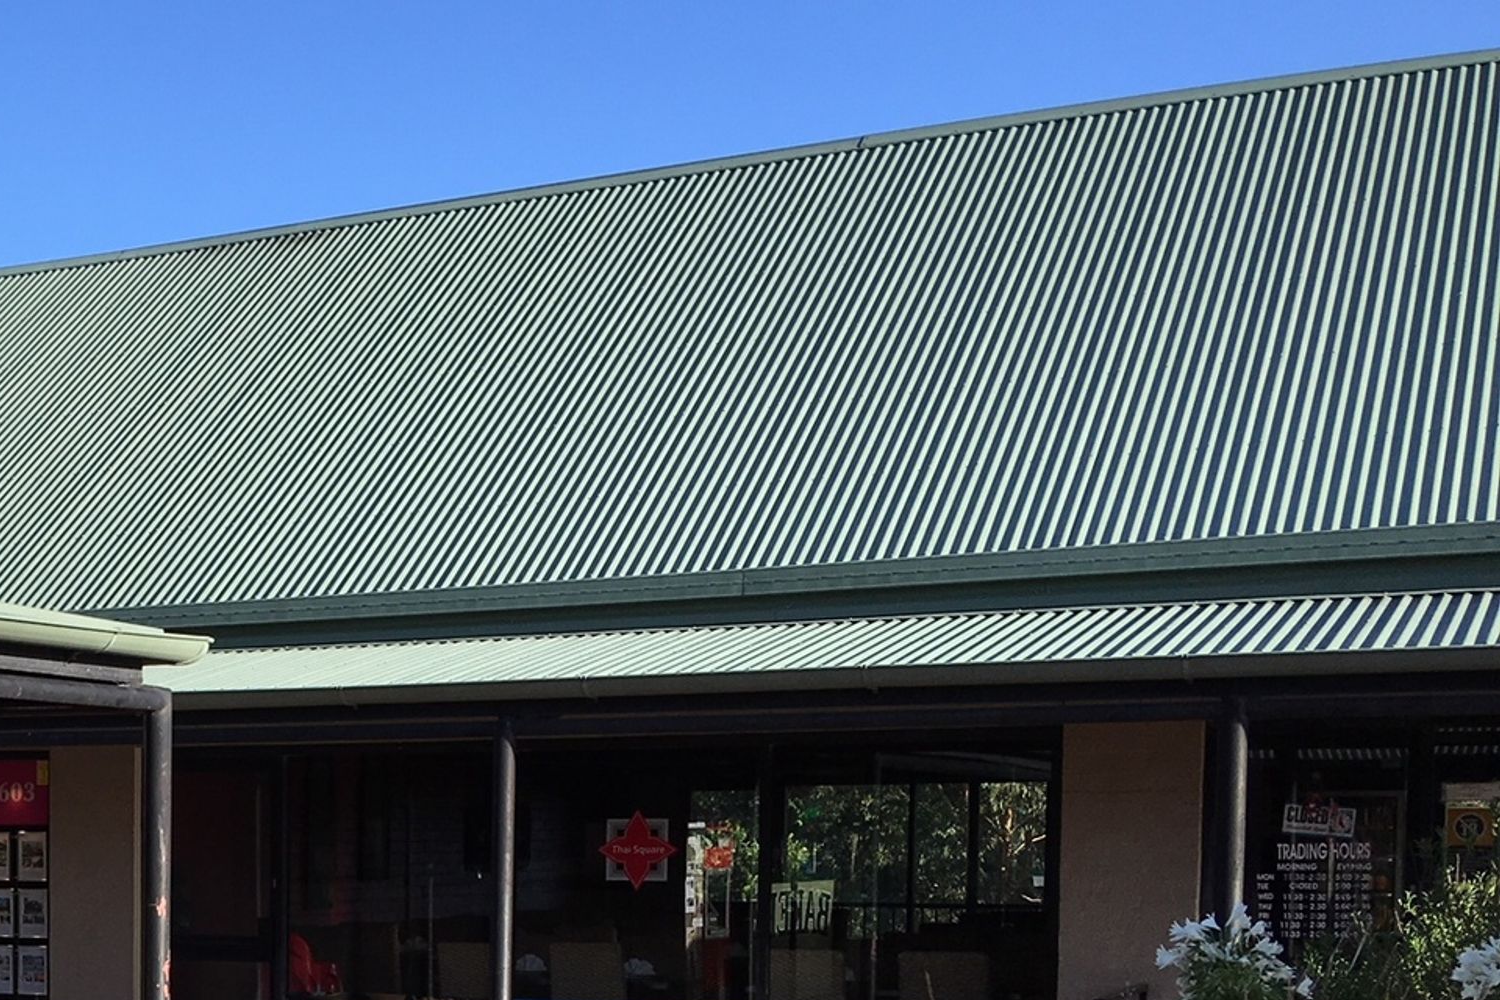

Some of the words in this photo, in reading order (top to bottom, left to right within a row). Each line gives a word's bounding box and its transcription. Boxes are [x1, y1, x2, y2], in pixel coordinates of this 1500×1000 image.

[612, 845, 631, 854] Thai
[633, 845, 665, 855] Square
[1277, 842, 1328, 860] TRADING
[1334, 842, 1371, 860] HOURS
[1276, 863, 1318, 871] MORNING
